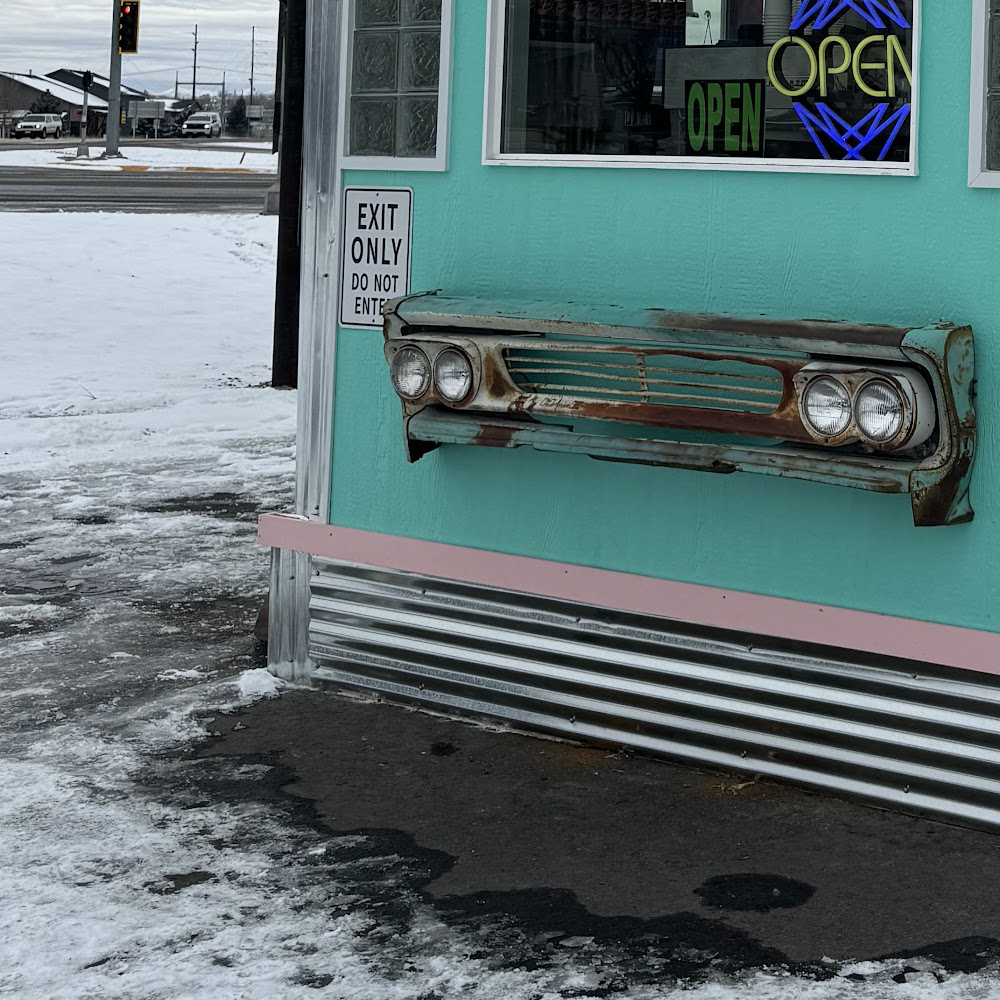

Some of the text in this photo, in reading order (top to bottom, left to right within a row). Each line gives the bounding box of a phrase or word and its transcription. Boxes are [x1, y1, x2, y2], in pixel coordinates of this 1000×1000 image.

[766, 34, 913, 98] OPEN
[687, 81, 762, 152] OPEN
[357, 202, 399, 231] EXIT
[351, 236, 402, 266] ONLY
[351, 272, 399, 293] DO NOT
[354, 296, 386, 316] ENTE
